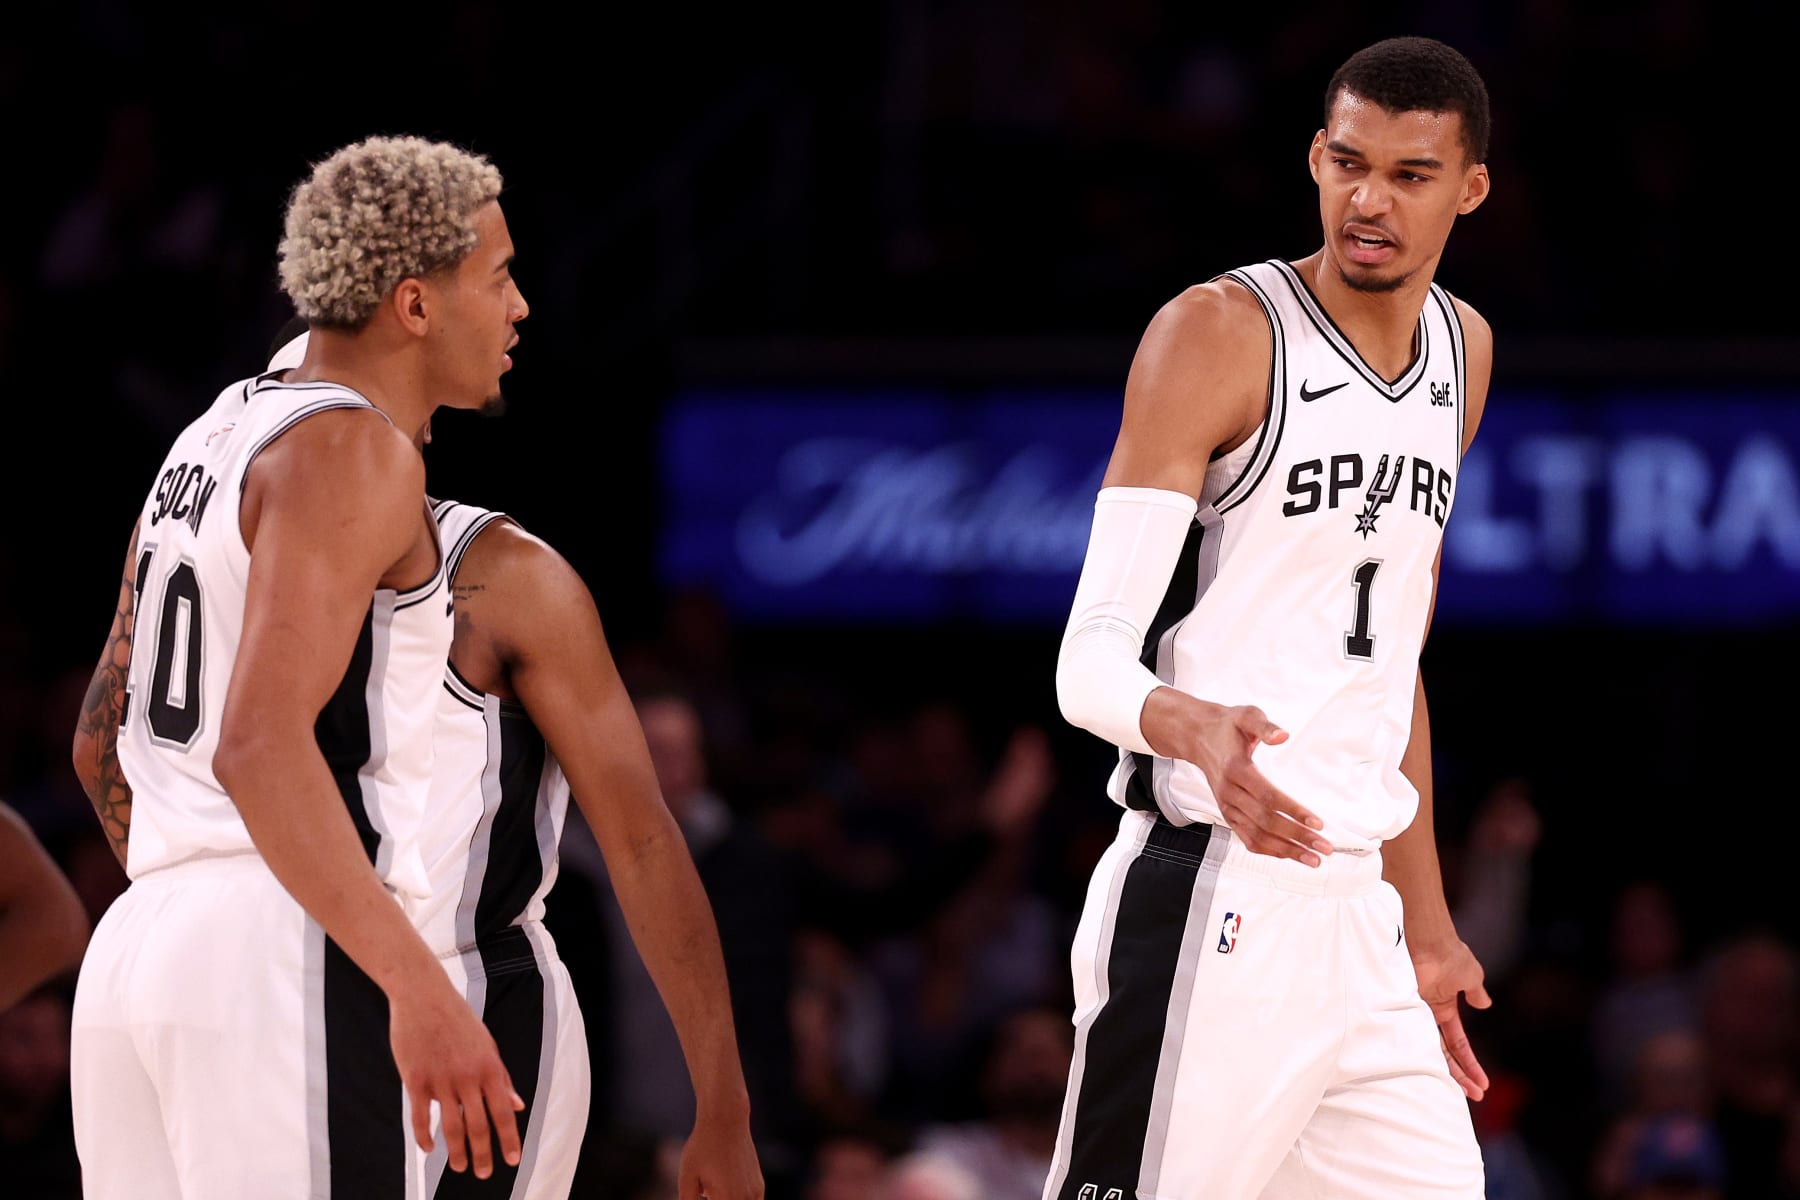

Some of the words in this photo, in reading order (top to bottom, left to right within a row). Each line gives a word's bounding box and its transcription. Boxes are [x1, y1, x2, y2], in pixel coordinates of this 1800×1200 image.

[1430, 381, 1453, 407] Self.
[1282, 452, 1452, 540] SPURS
[1450, 434, 1800, 572] LTRA
[1343, 557, 1384, 663] 1
